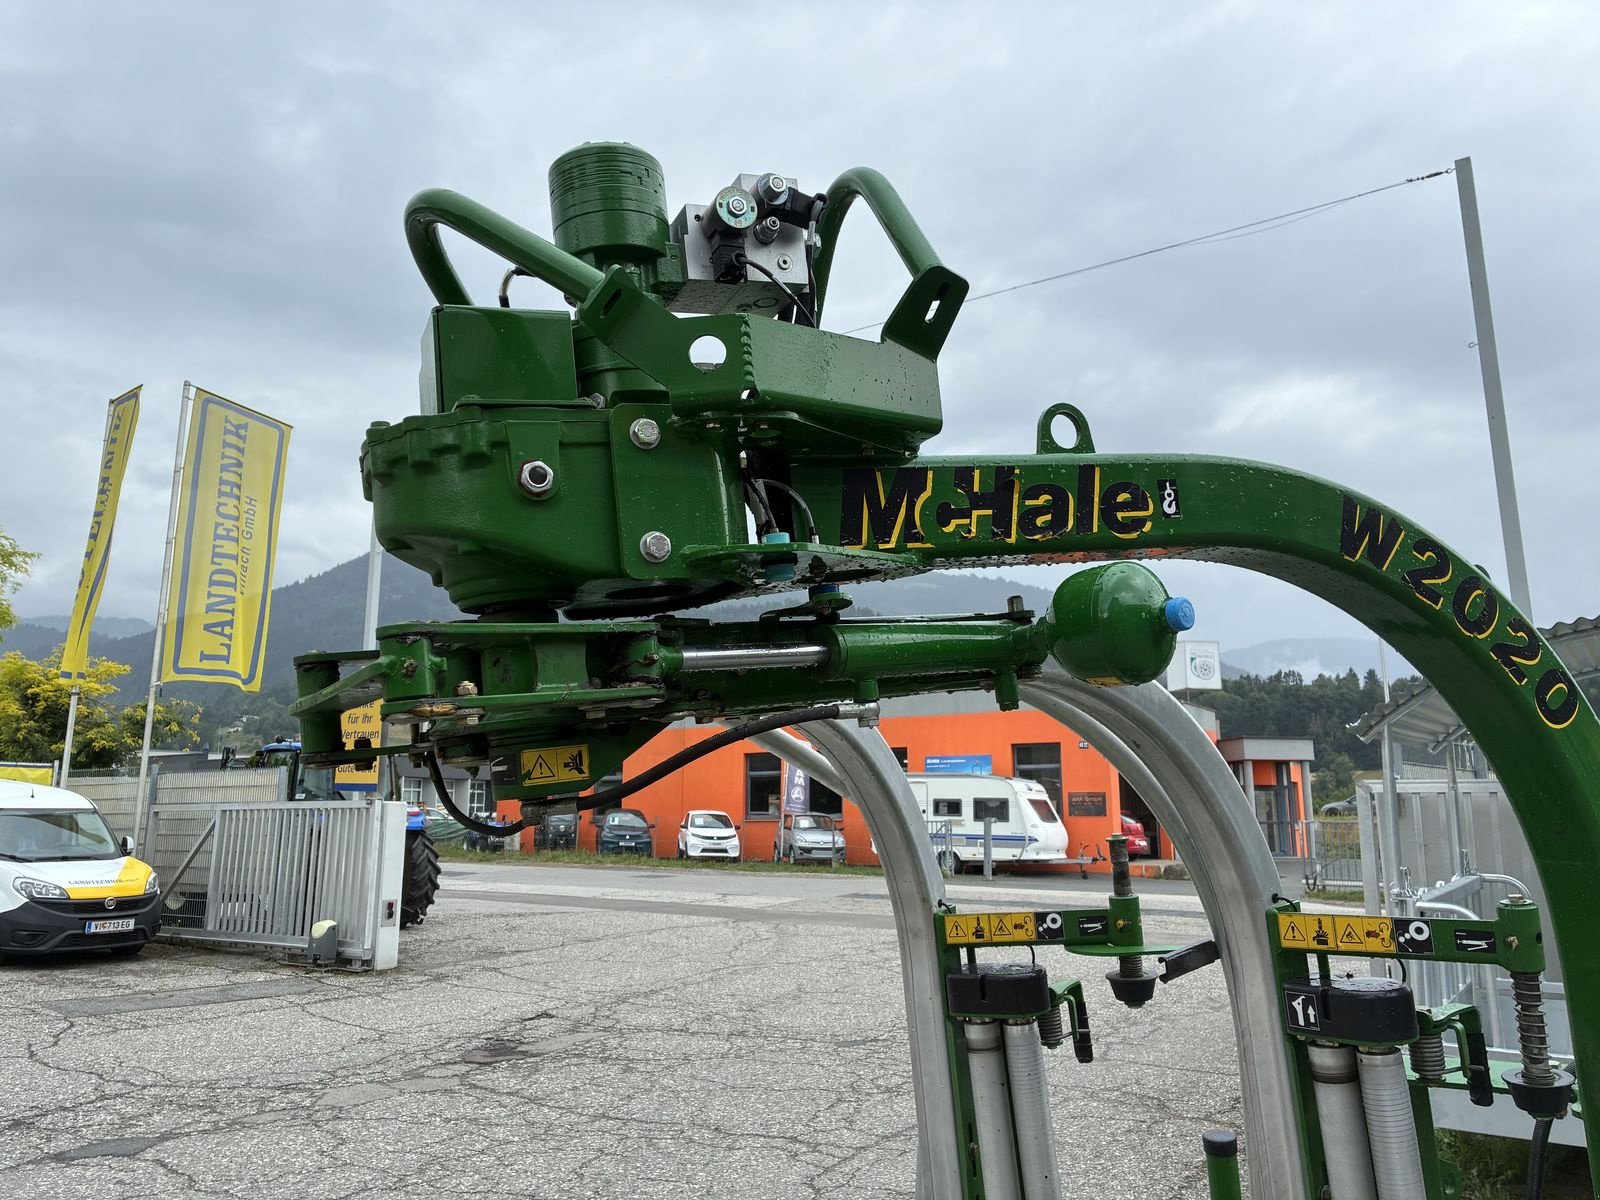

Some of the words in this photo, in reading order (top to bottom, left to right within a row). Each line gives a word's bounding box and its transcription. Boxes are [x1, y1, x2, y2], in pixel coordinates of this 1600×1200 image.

[199, 415, 248, 664] LANDTECHNIK
[242, 496, 257, 540] GmbH
[840, 464, 1153, 549] McHale
[1340, 495, 1580, 729] W2020
[348, 713, 360, 724] für
[362, 713, 373, 724] Ihr
